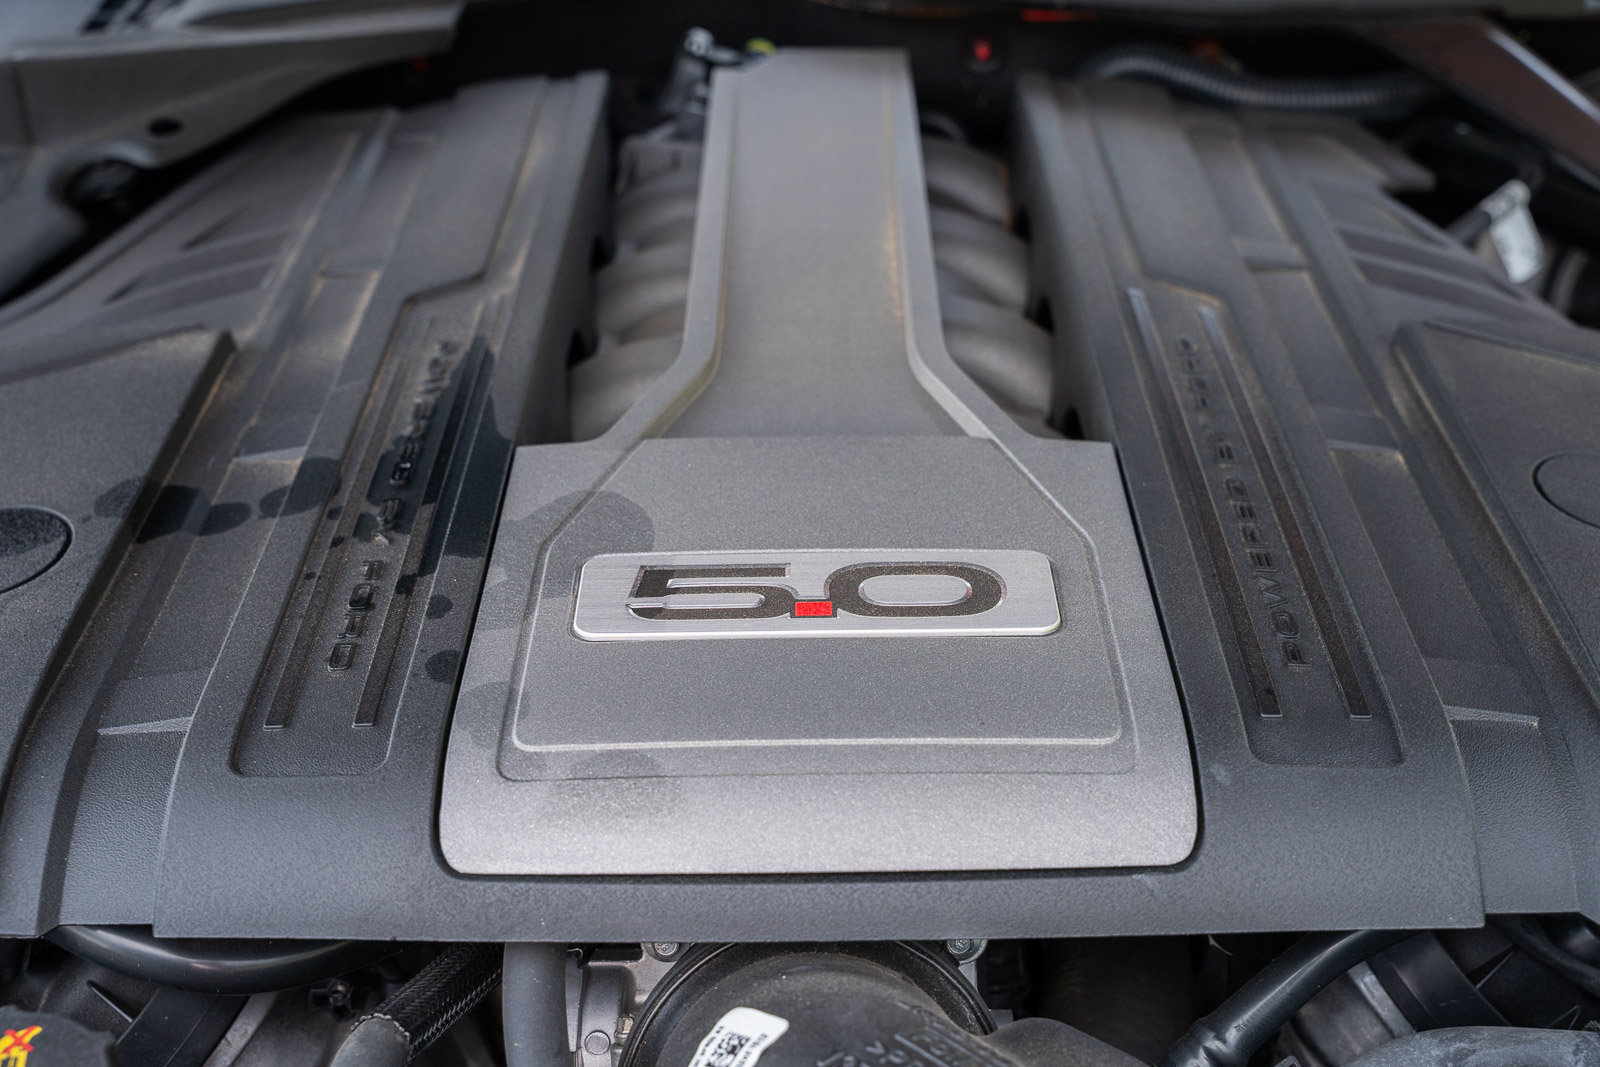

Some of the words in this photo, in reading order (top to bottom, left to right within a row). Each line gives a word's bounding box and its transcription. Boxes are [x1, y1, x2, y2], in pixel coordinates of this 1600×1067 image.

[390, 340, 456, 485] POWERED
[372, 498, 401, 546] BY
[1224, 477, 1312, 668] POWERED
[327, 558, 385, 671] FORD
[625, 562, 1007, 620] 5.0
